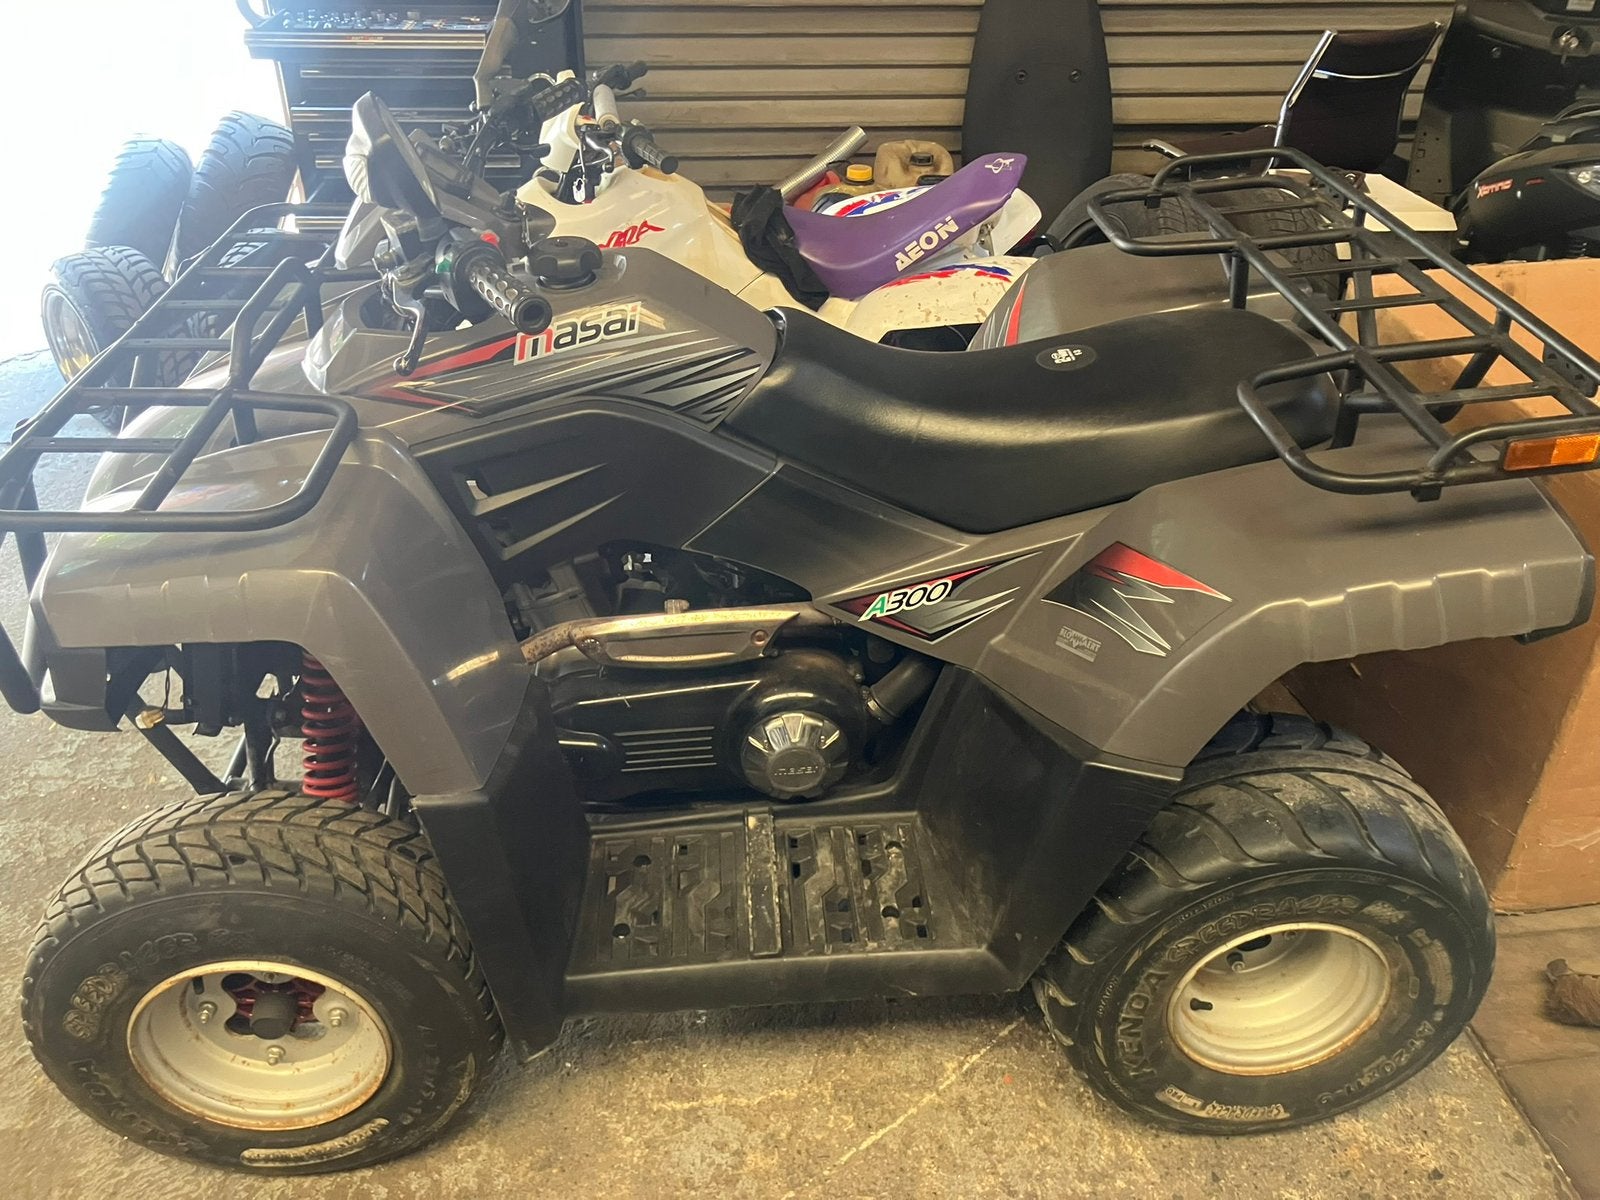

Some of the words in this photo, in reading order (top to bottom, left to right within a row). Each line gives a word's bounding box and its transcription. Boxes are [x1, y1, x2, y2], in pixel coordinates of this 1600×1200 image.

[894, 215, 959, 272] AEON
[514, 302, 640, 363] masai
[860, 580, 952, 620] A300
[1117, 968, 1170, 1077] KENDA
